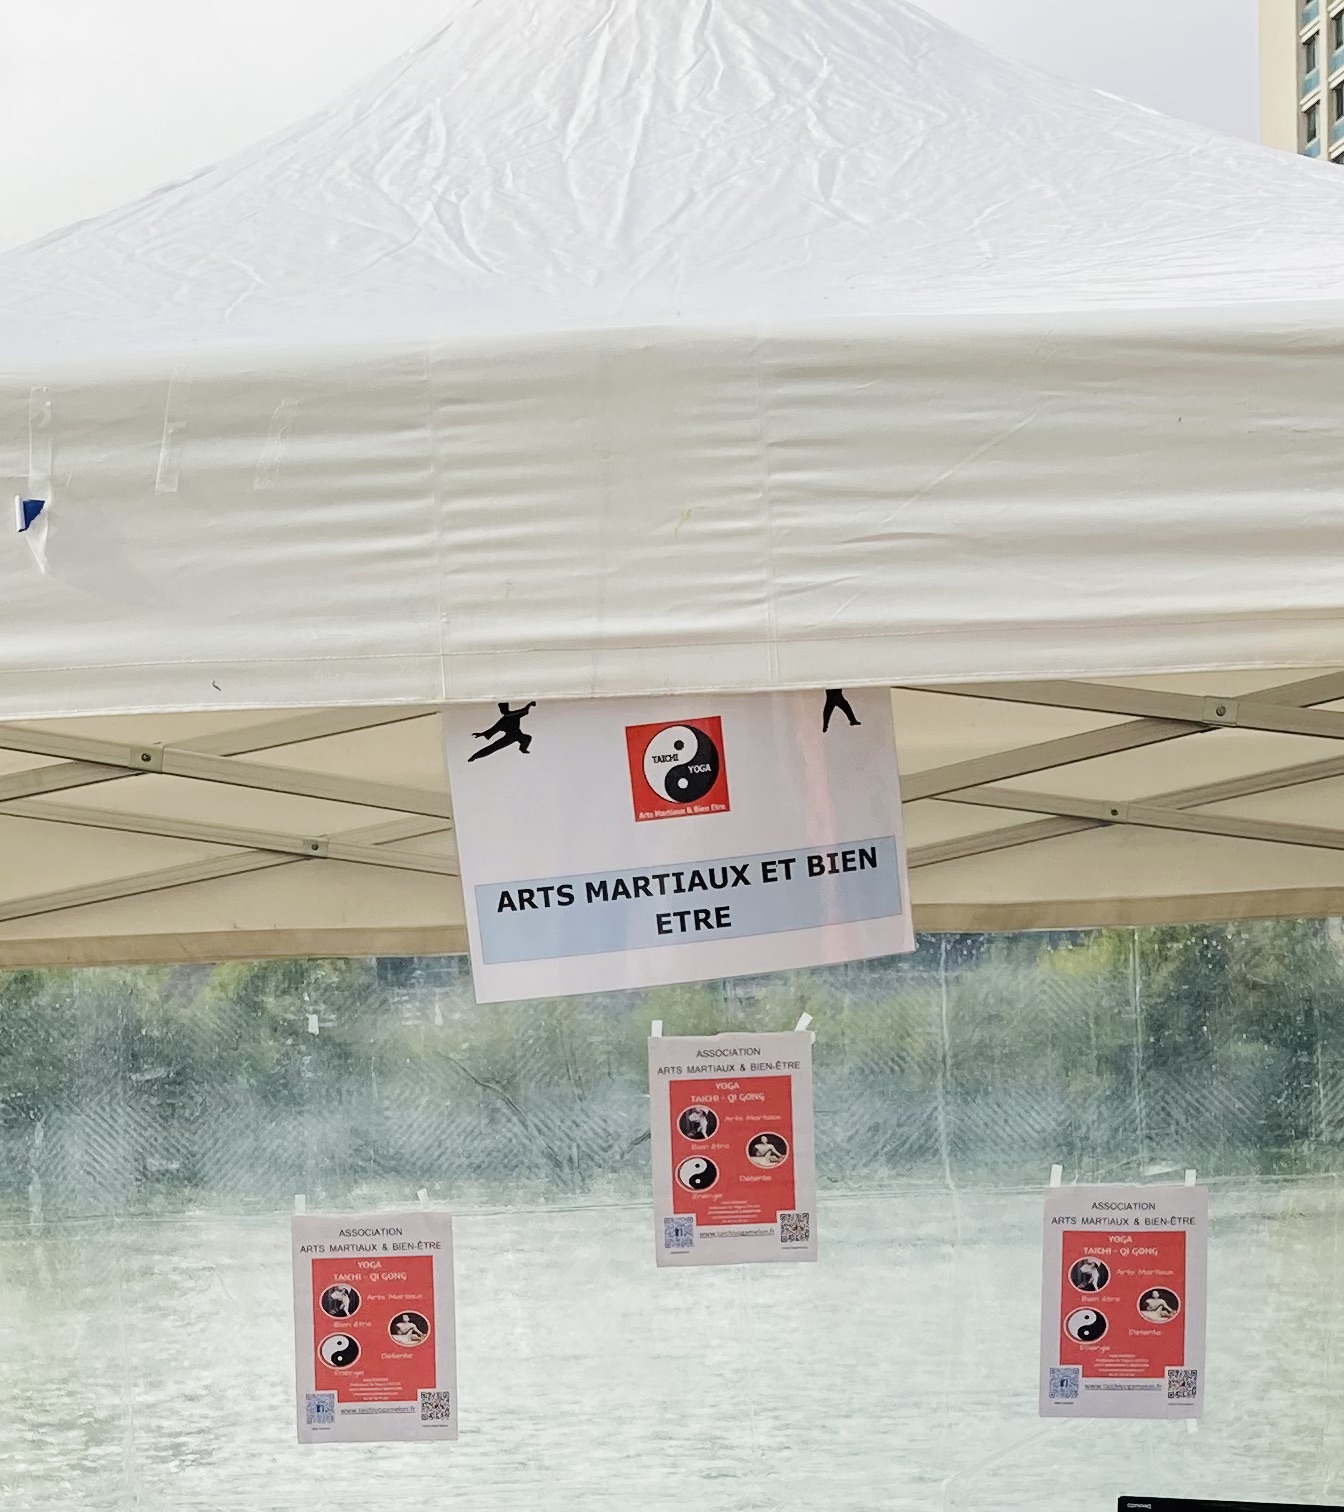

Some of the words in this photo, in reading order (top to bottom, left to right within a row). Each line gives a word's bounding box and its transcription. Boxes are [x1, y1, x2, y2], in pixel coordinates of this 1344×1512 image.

[688, 764, 711, 773] YOGA
[497, 884, 575, 913] ARTS
[586, 864, 752, 903] MARTIAUX
[761, 858, 796, 882] ET
[808, 847, 878, 877] BIEN
[656, 906, 732, 935] ETRE
[696, 1048, 761, 1058] ASSOCIATION
[657, 1066, 682, 1075] ARTS
[687, 1064, 735, 1074] MARTIAUX
[1092, 1202, 1156, 1211] ASSOCIATION
[1051, 1217, 1077, 1225] ARTS
[1081, 1217, 1129, 1225] MARTIAUX
[339, 1228, 403, 1237] ASSOCIATION
[300, 1244, 325, 1254] ARTS
[330, 1243, 378, 1252] MARTIAUX
